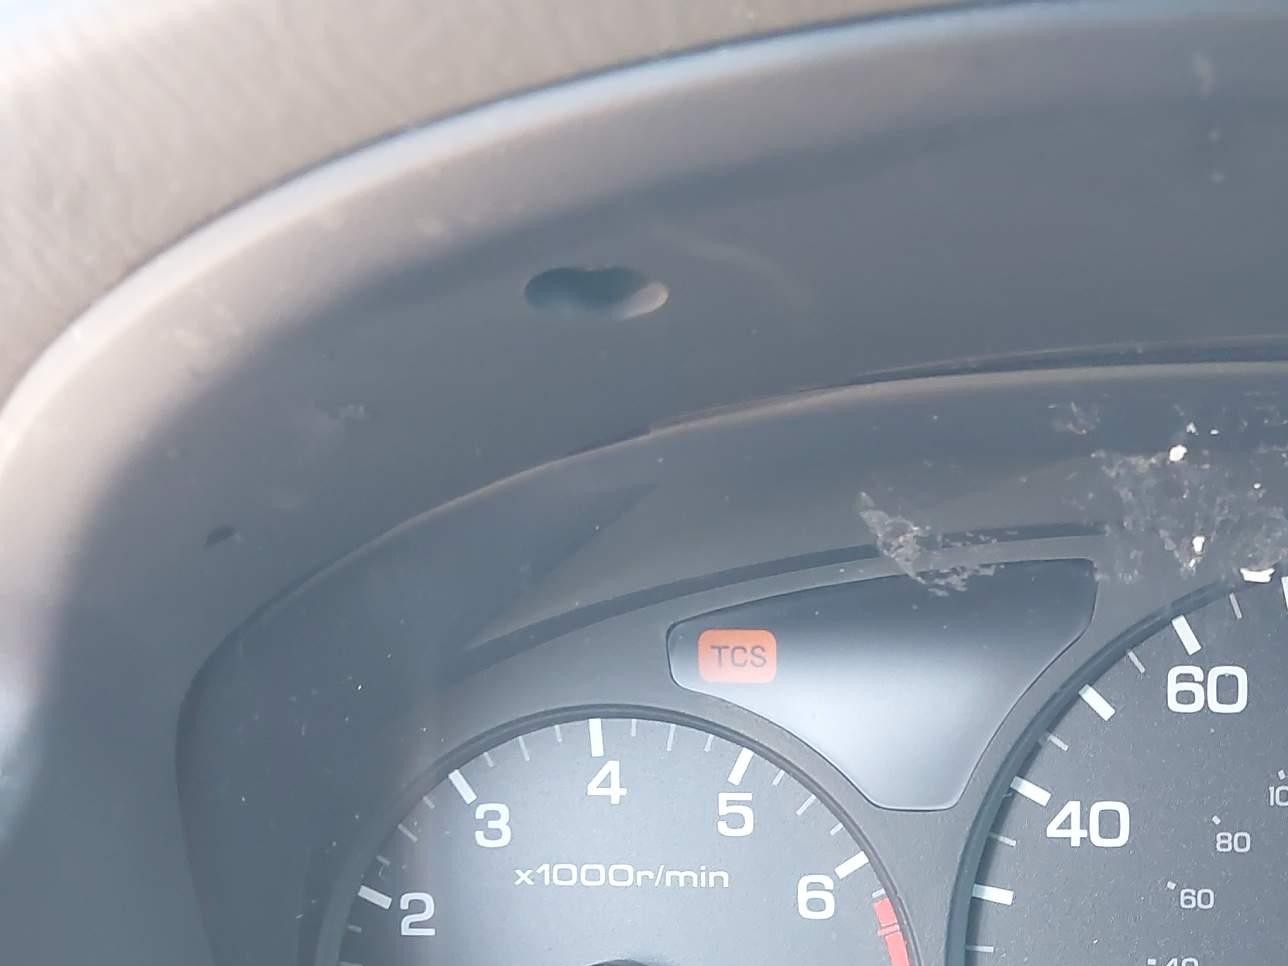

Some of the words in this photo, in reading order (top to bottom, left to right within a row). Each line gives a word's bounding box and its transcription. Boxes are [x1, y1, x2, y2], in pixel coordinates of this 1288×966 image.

[710, 644, 767, 668] TCS
[1167, 665, 1248, 714] 60
[587, 760, 628, 805] 4
[473, 802, 513, 848] 3
[717, 792, 754, 837] 5
[1045, 800, 1130, 848] 40
[1216, 831, 1251, 853] 80
[400, 892, 436, 936] 2
[796, 874, 836, 920] 6
[1180, 888, 1215, 909] 60
